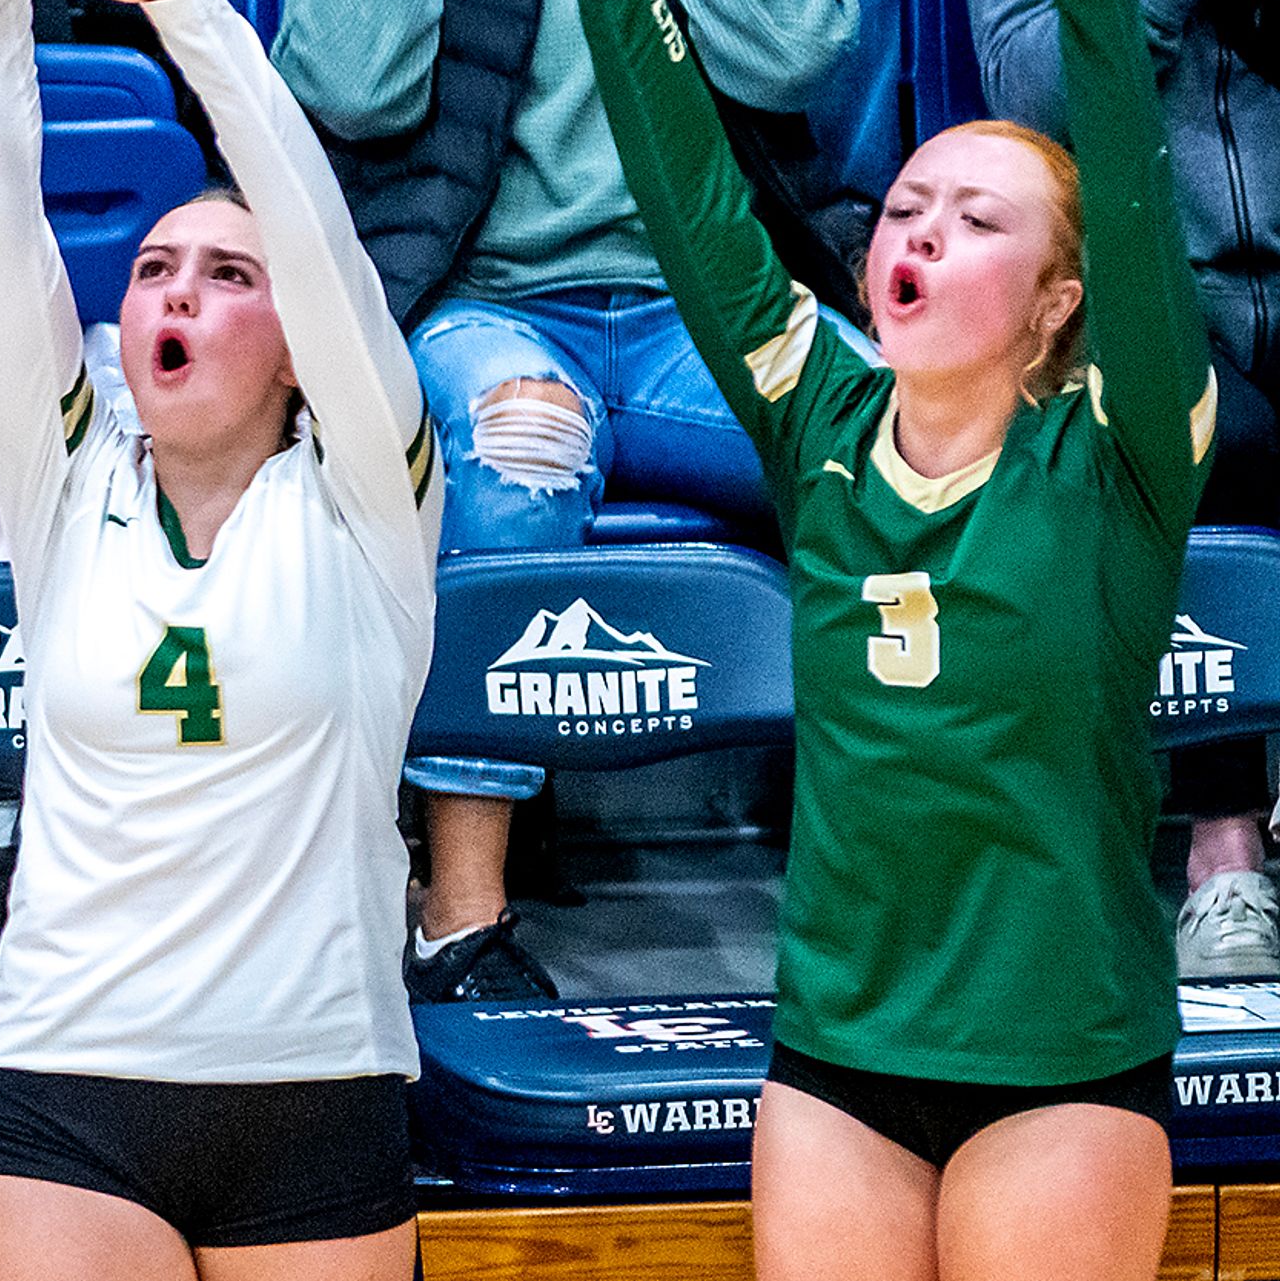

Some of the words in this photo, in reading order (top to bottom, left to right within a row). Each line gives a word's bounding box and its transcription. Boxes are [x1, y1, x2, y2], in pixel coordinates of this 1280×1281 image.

[861, 571, 941, 688] 3
[136, 622, 225, 746] 4
[485, 666, 698, 715] GRANITE
[1149, 697, 1229, 716] CEPTS
[558, 715, 693, 736] CONCEPTS
[614, 1039, 765, 1054] STATE
